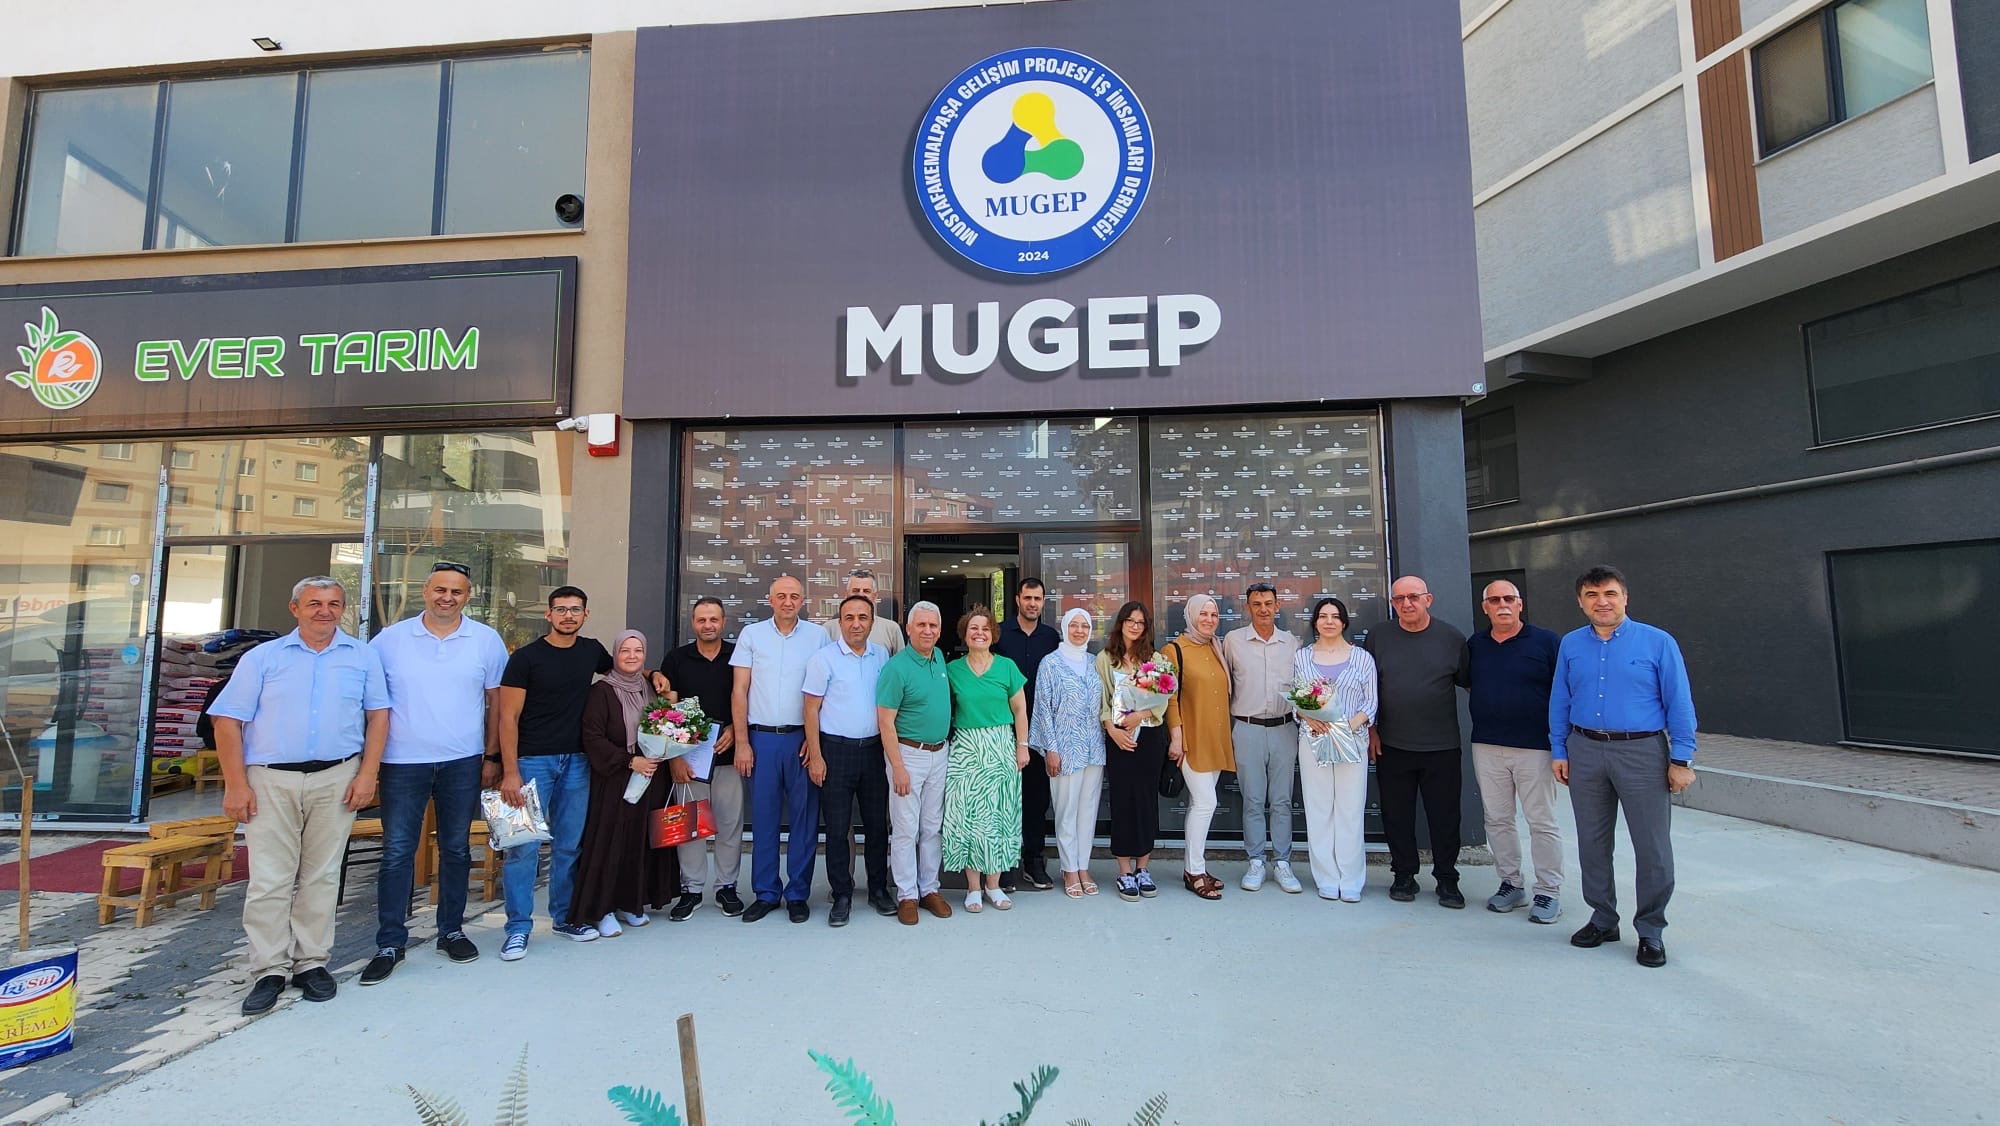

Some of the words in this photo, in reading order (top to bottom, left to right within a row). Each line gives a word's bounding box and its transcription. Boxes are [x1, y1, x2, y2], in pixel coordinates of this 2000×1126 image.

[957, 59, 1020, 100] GELİŞİM
[1024, 57, 1095, 83] PROJESİ
[1091, 73, 1112, 97] İŞ
[1106, 88, 1145, 173] İNSANLARI
[923, 97, 979, 247] MUSTAFAKEMALPAŞA
[984, 191, 1088, 218] MUGEP
[1091, 175, 1142, 242] DERNEĞİ
[1017, 250, 1050, 262] 2024
[134, 335, 286, 382] EVER
[299, 326, 480, 376] TARIM
[846, 293, 1222, 377] MUGEP
